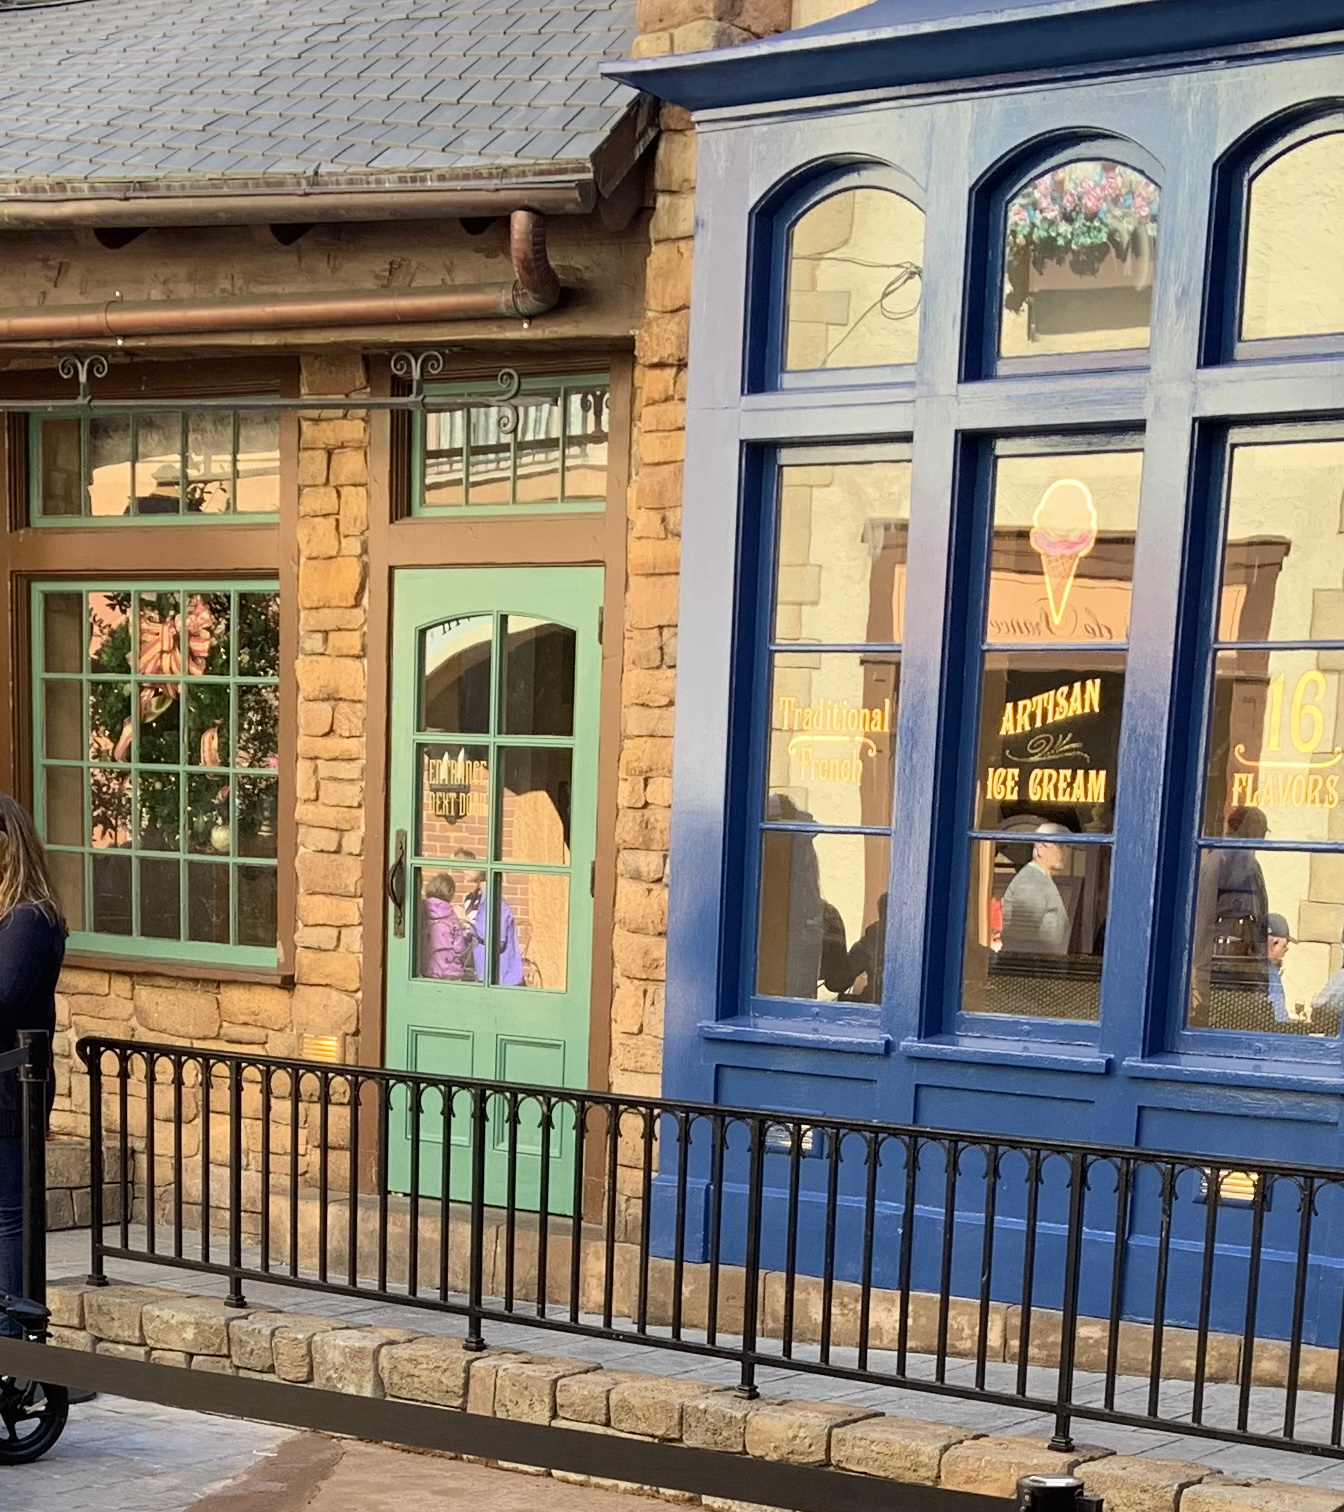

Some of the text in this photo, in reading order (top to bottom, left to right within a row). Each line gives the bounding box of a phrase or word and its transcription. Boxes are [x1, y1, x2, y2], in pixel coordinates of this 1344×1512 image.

[778, 696, 891, 733] Traditional
[999, 678, 1101, 735] ARTISAN
[1267, 669, 1327, 753] 16
[799, 747, 864, 784] French
[986, 767, 1107, 803] ICE CREAM
[1231, 772, 1340, 809] FLAVORS
